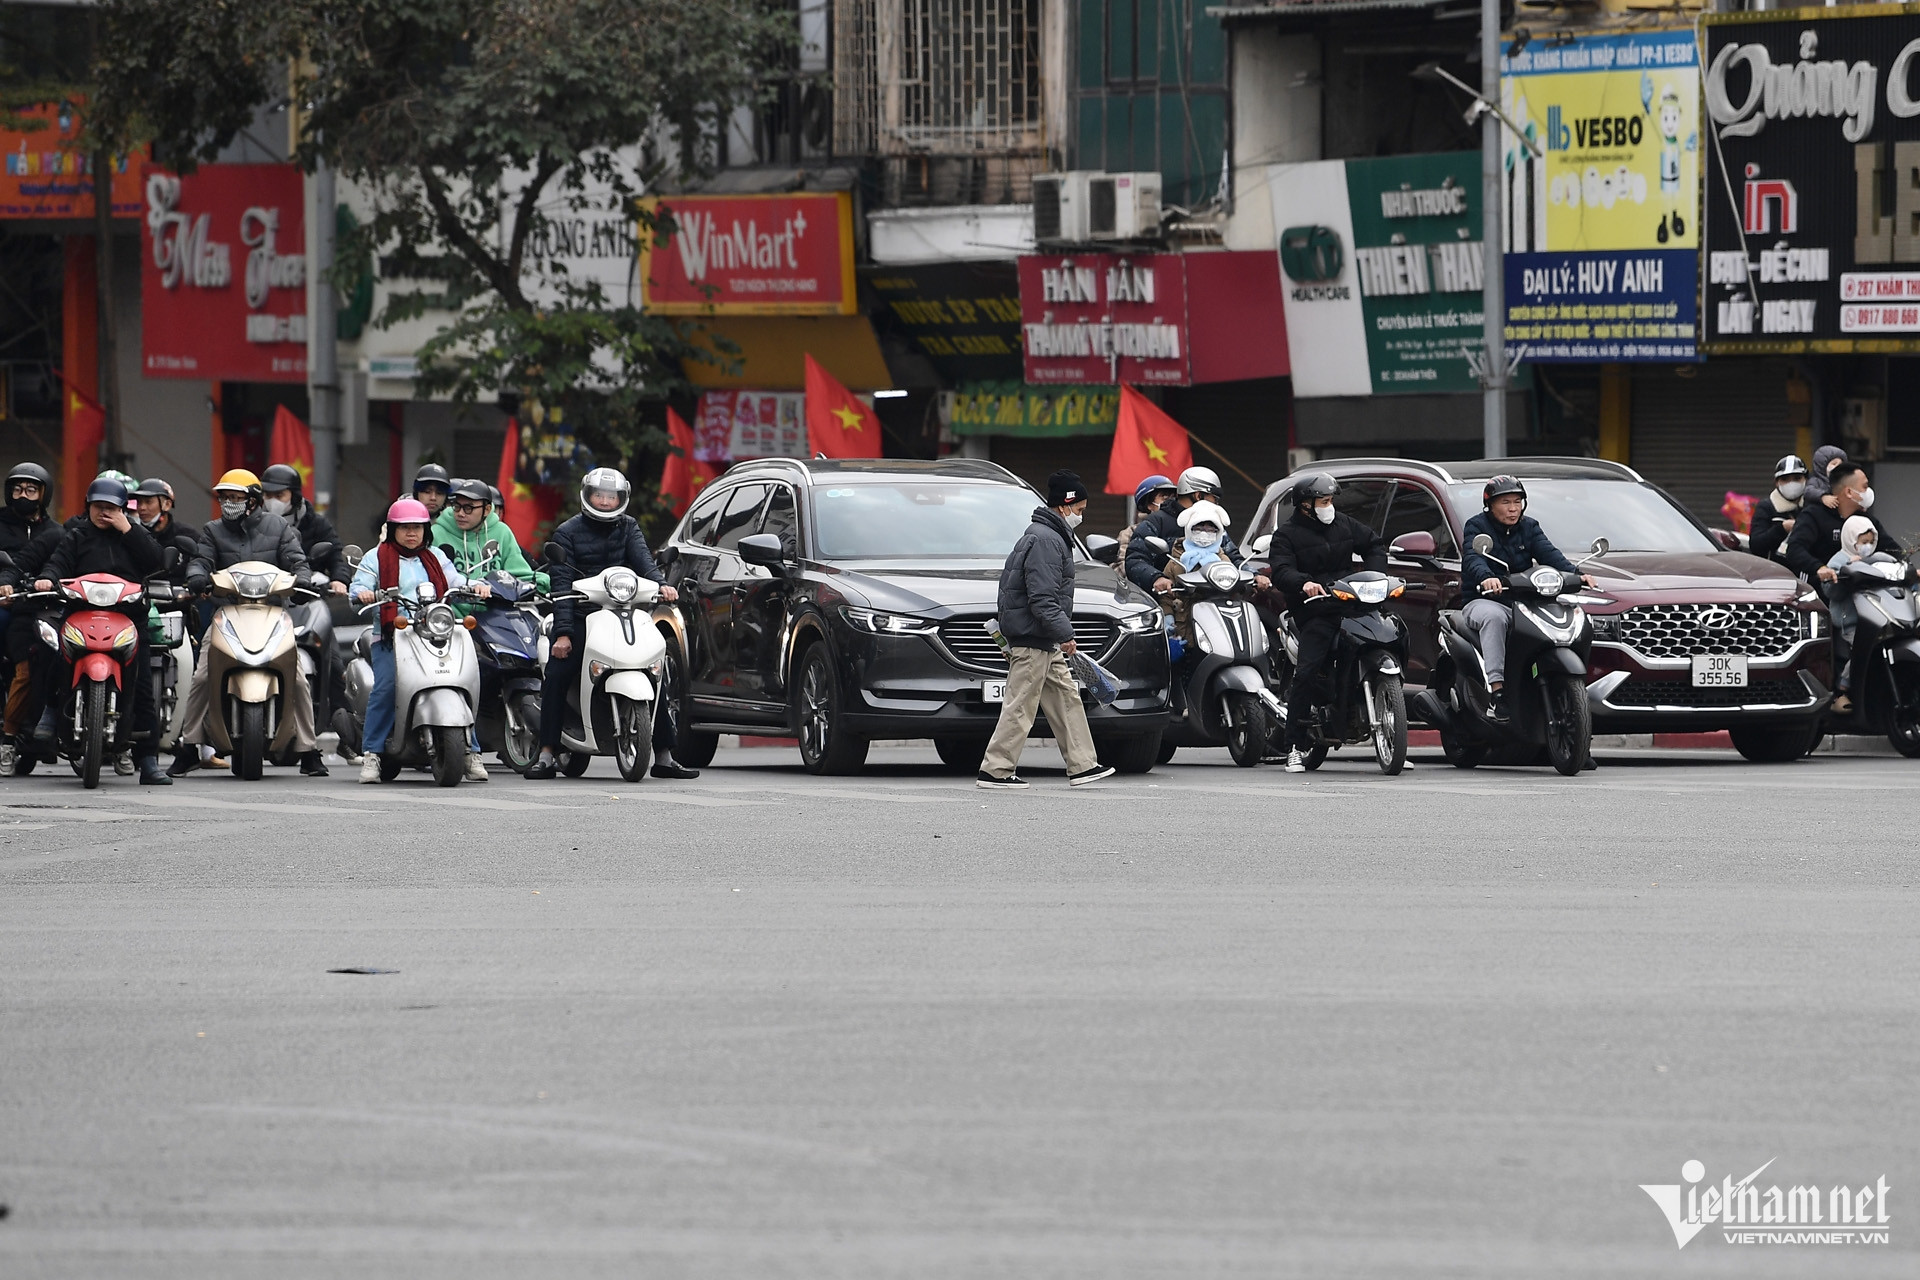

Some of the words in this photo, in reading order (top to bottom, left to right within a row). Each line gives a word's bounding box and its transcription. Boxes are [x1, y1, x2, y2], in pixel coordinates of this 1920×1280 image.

[1707, 30, 1877, 142] Quảng
[1575, 115, 1643, 148] VESBO
[1744, 163, 1797, 234] in
[1355, 233, 1431, 296] THIÊN
[1523, 268, 1549, 302] ĐẠI
[1552, 260, 1574, 294] LÝ:
[1578, 260, 1617, 294] HUY
[1621, 259, 1663, 293] ANH
[1762, 298, 1816, 333] NGAY
[1698, 673, 1742, 685] 355.56
[1708, 658, 1731, 670] 30K
